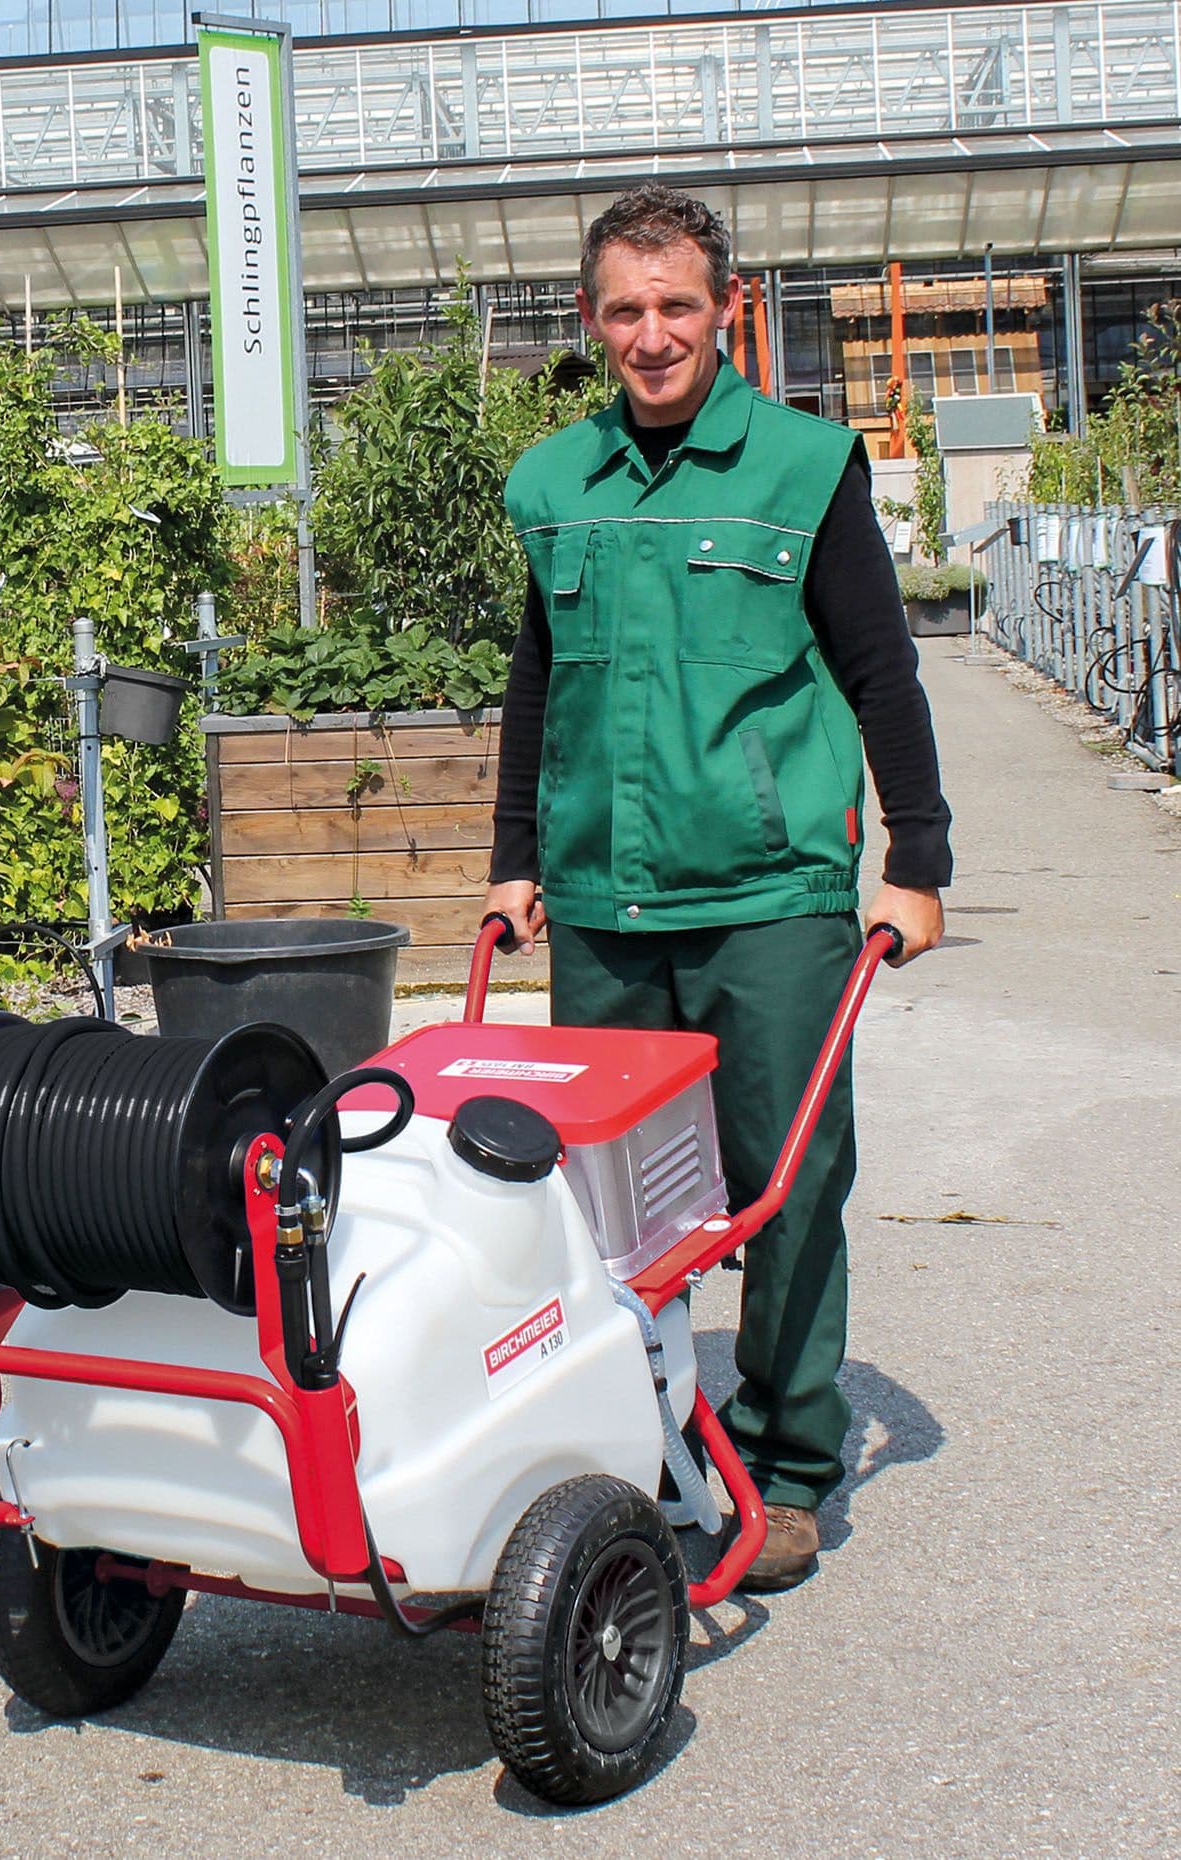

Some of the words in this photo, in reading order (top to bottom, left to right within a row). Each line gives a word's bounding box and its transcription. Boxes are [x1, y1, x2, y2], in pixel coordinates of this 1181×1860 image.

[235, 66, 263, 354] Schlingpflanzen
[489, 1308, 558, 1368] BIRCHMEIER
[540, 1342, 548, 1359] A
[548, 1330, 563, 1352] 130
